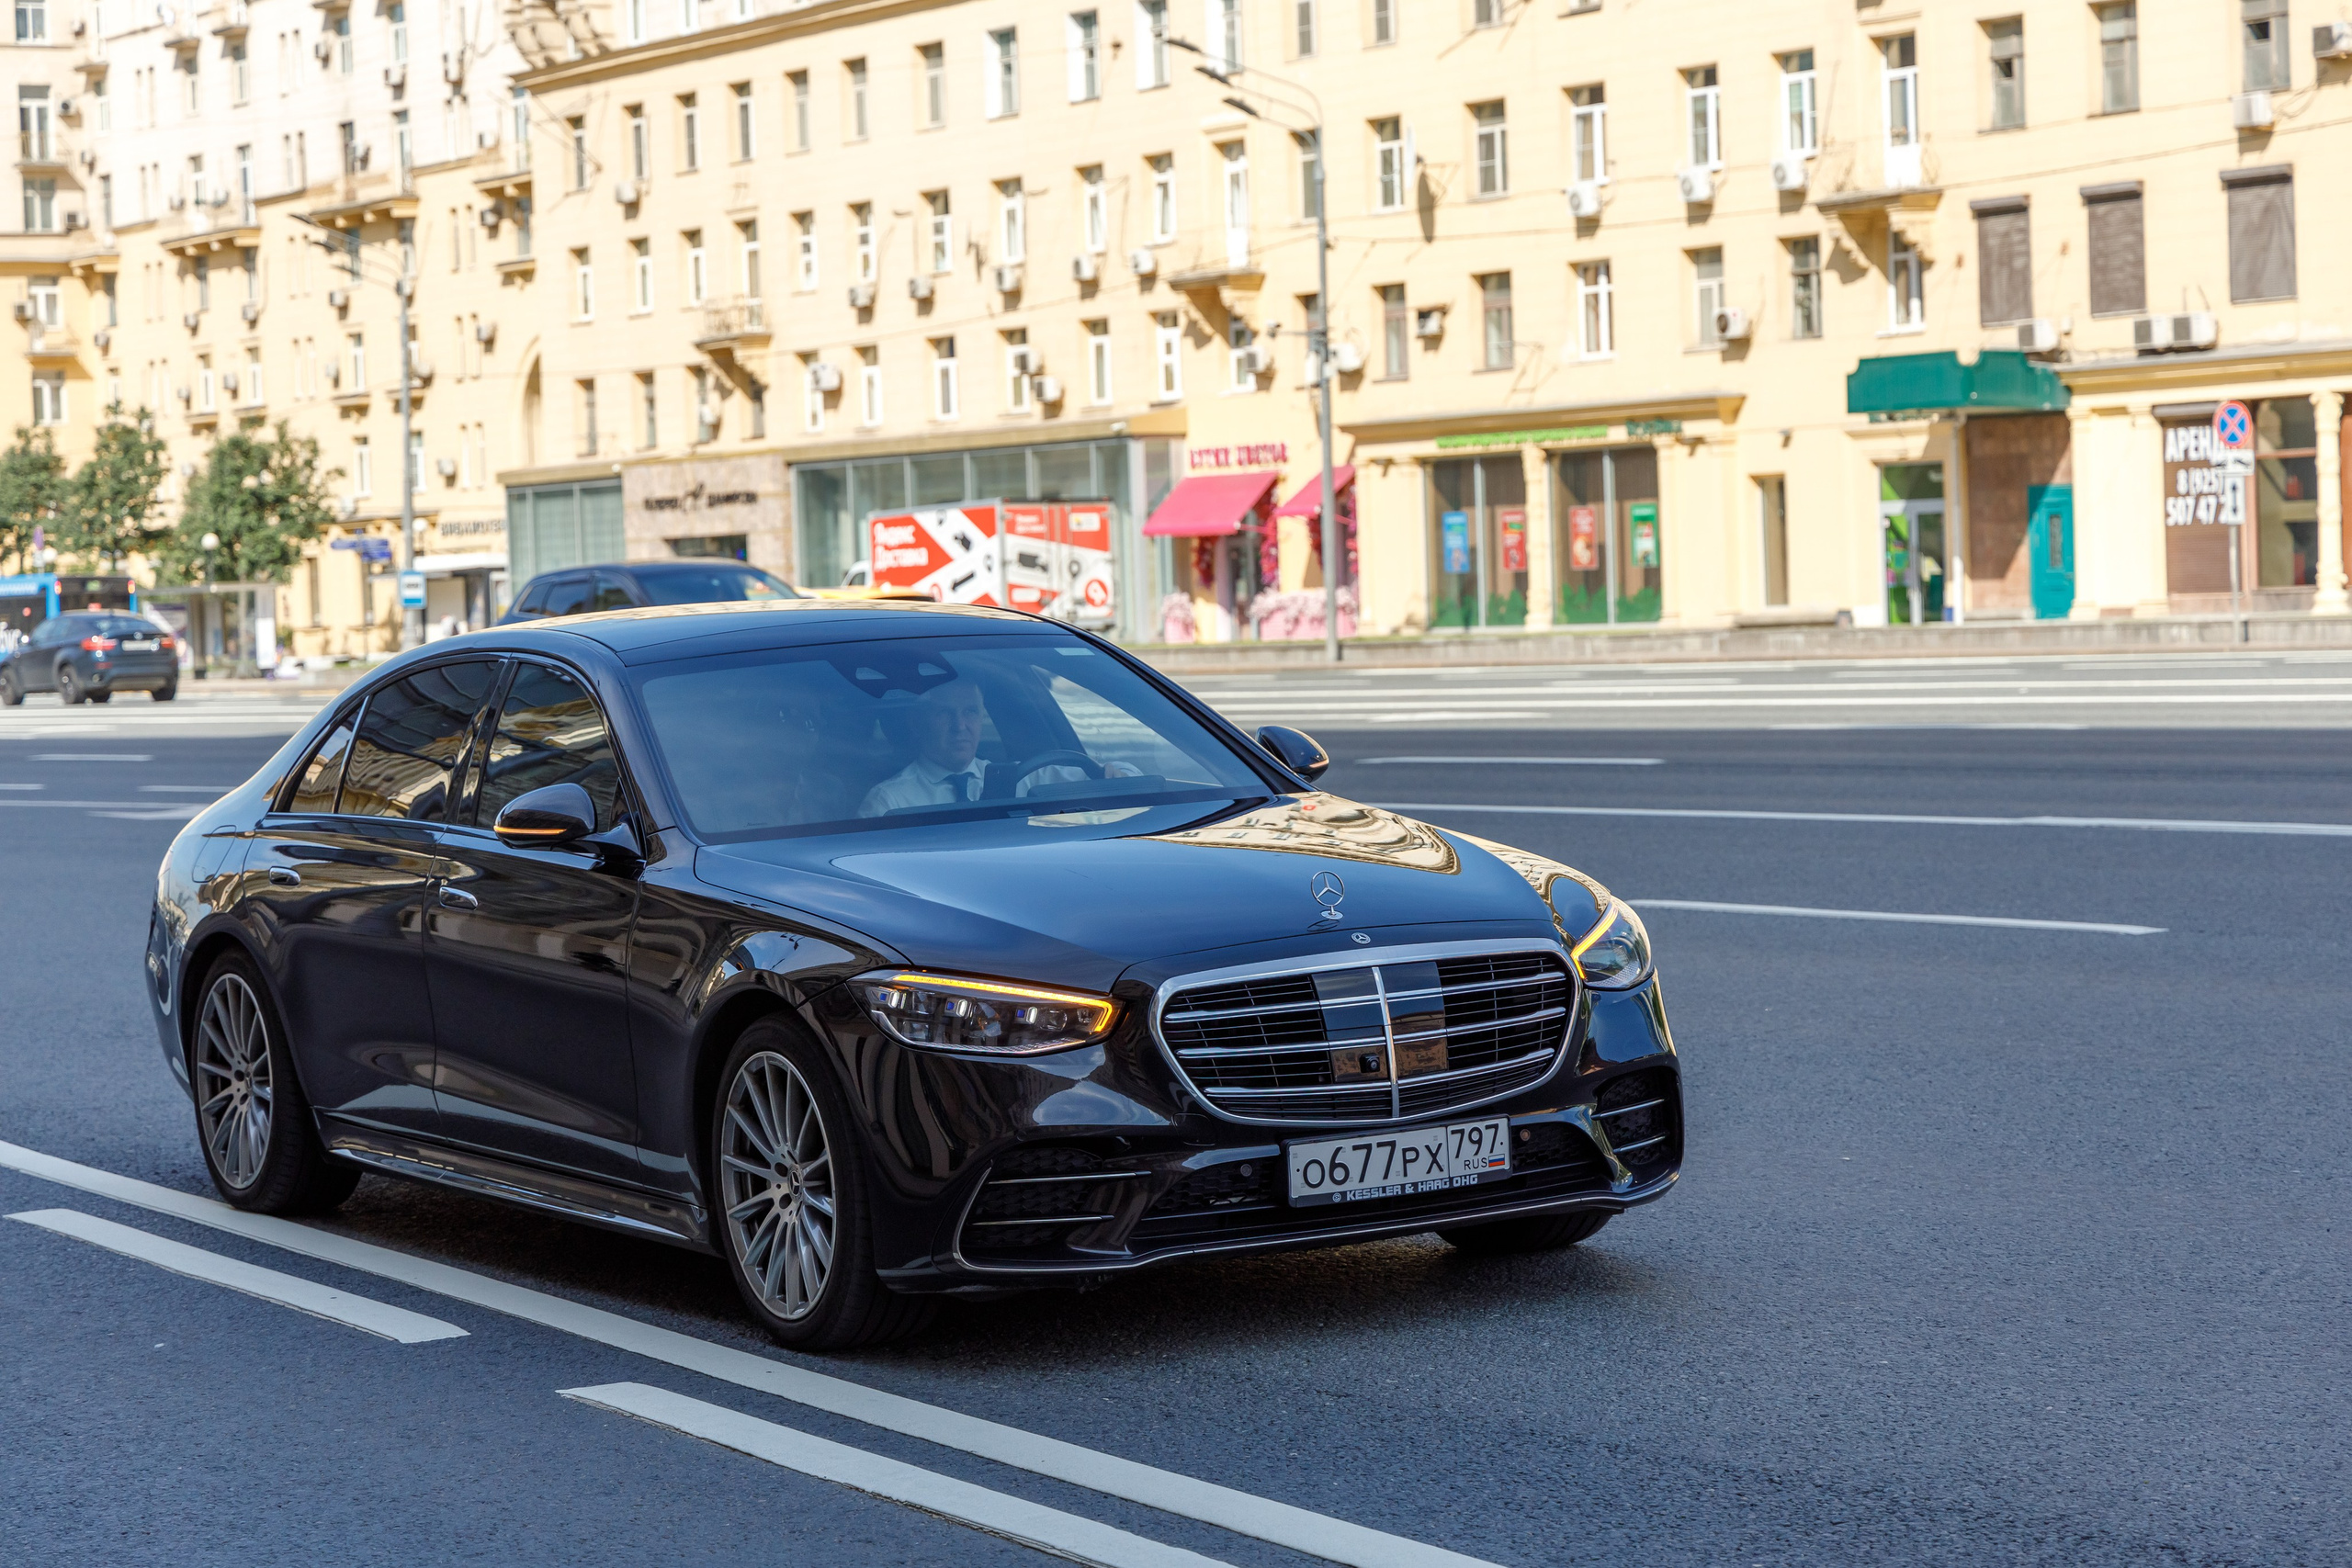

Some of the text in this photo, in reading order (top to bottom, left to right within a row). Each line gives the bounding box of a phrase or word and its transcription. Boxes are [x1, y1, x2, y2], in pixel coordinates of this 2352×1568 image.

[2177, 468, 2188, 495] 8
[2165, 496, 2196, 526] 507
[2196, 495, 2217, 525] 47
[1451, 1123, 1499, 1158] 797
[1464, 1157, 1487, 1170] RUS
[1347, 1174, 1478, 1201] KESSLER & HAAG OHG
